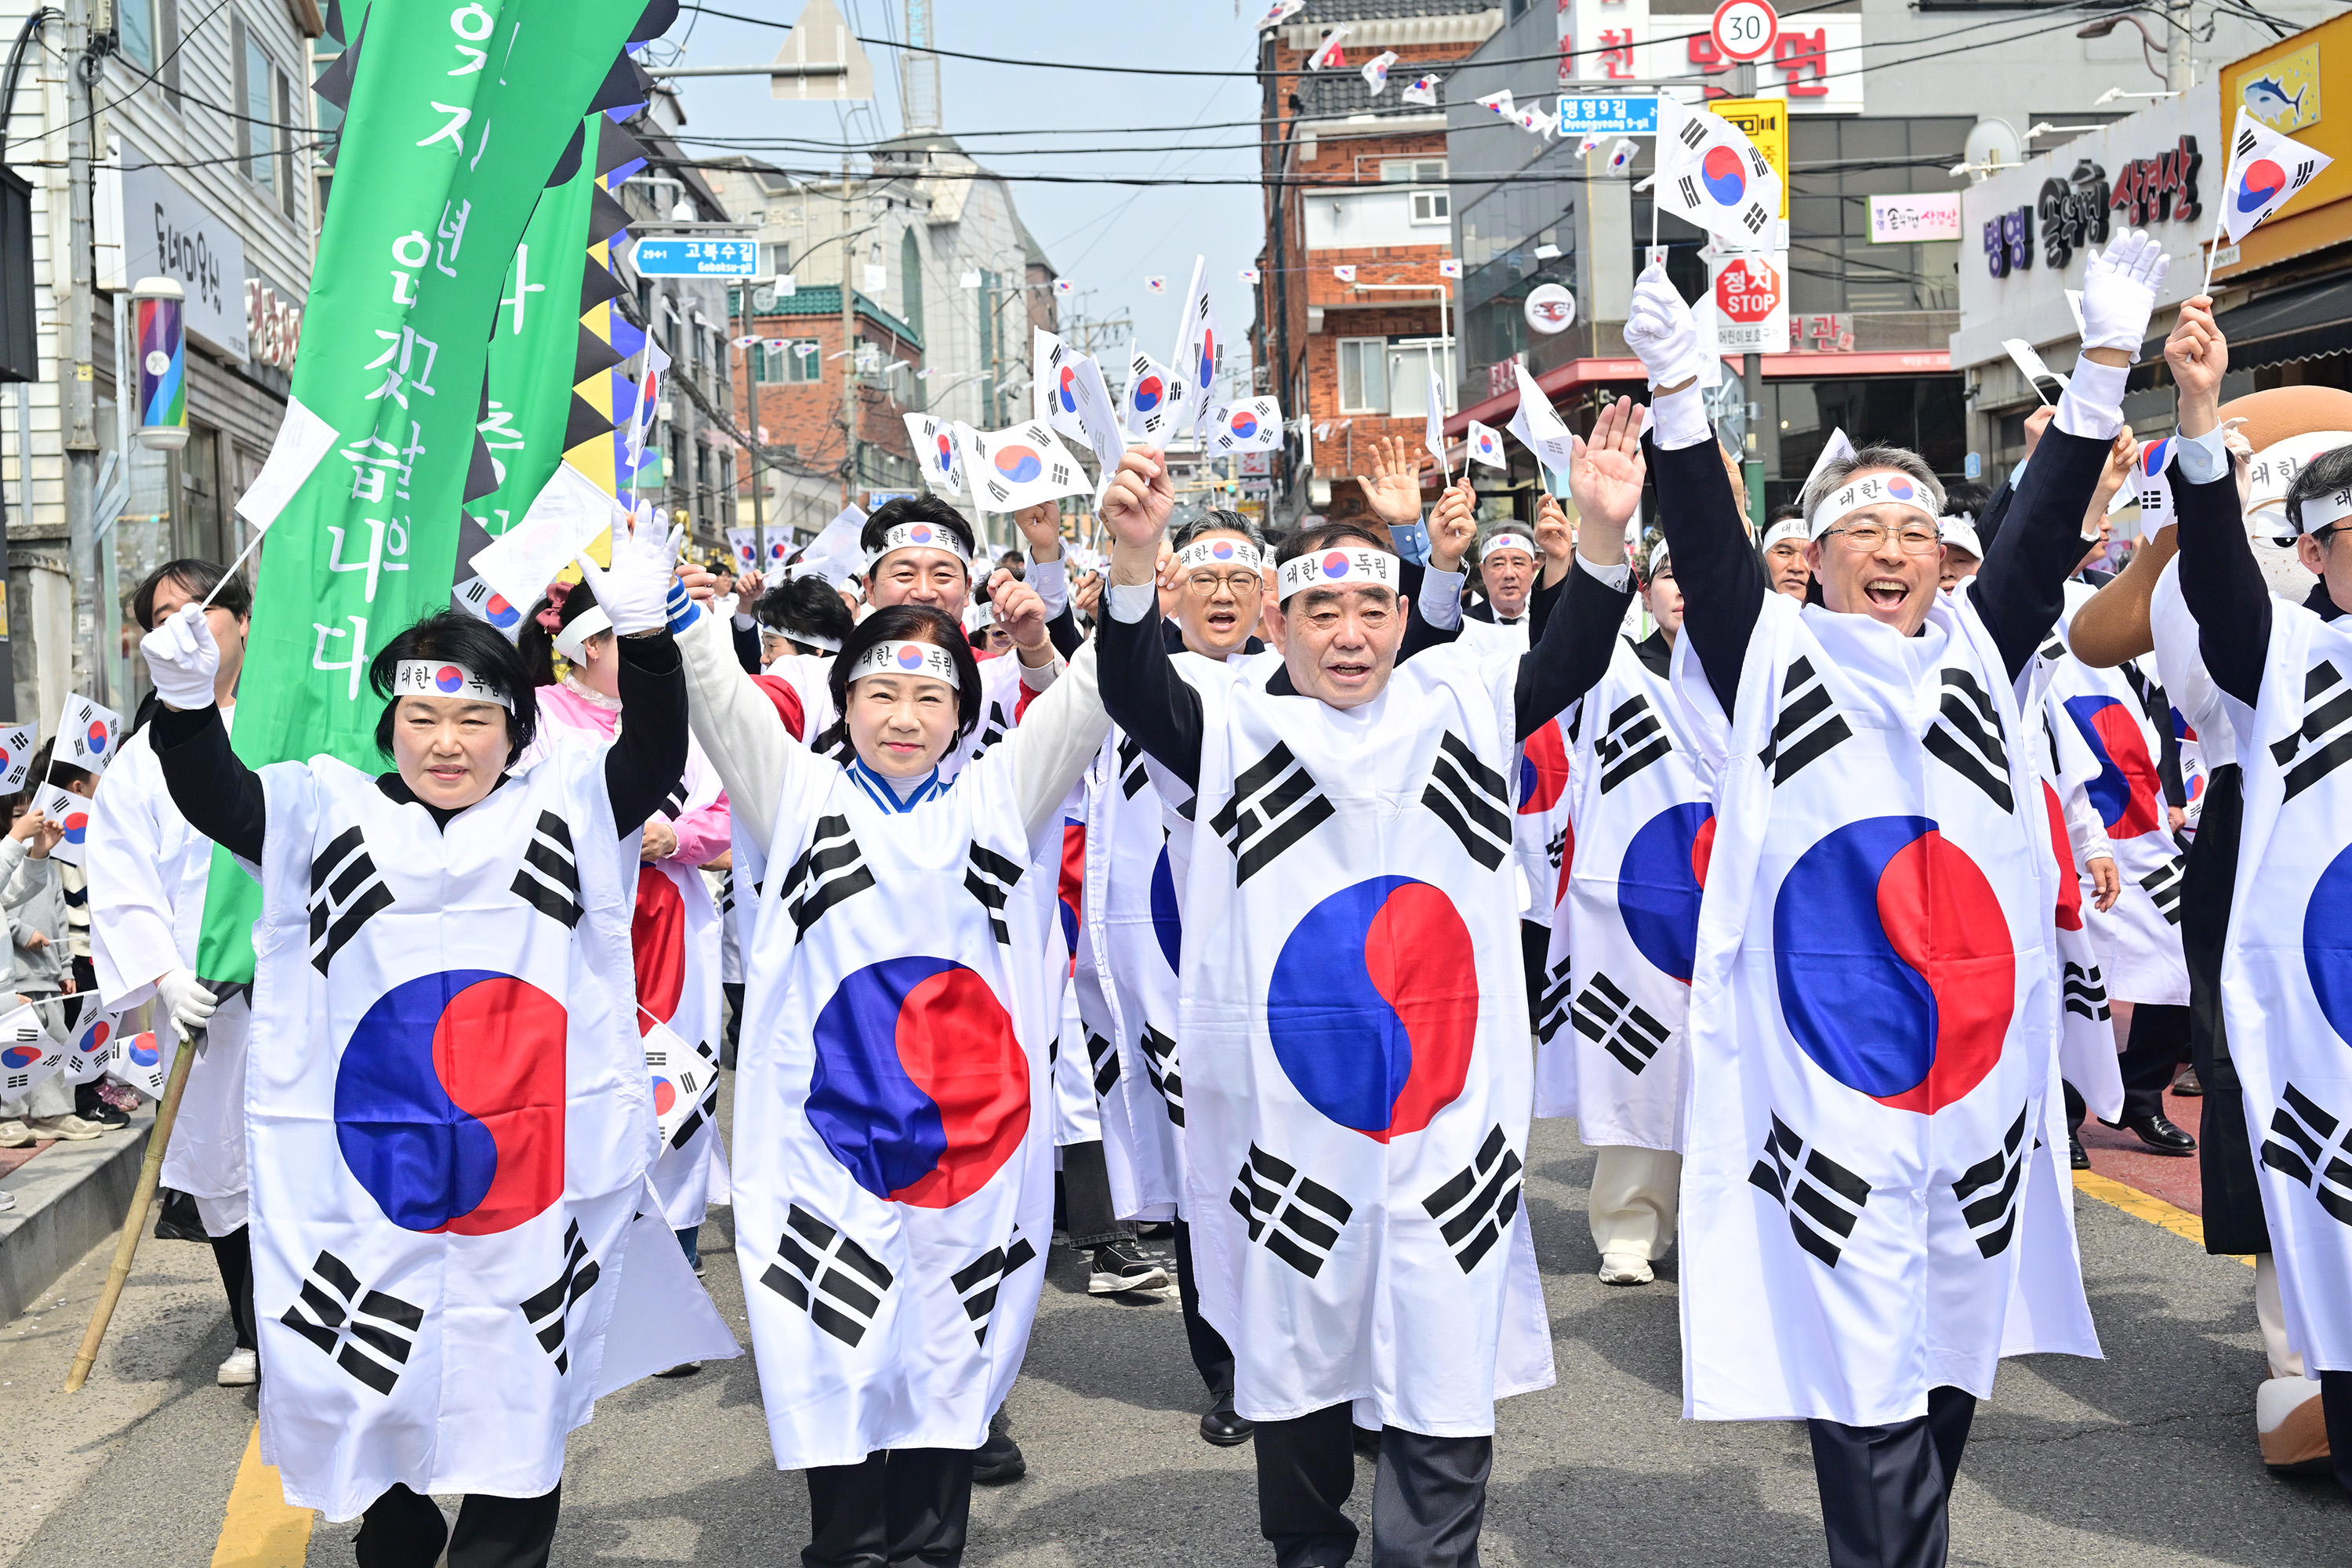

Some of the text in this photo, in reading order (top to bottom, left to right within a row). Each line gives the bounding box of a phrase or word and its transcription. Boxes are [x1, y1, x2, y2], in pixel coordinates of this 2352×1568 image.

[1730, 16, 1761, 41] 30
[154, 202, 221, 314] 동네미용실
[685, 243, 753, 262] 고복수길
[698, 262, 753, 273] Goboksu-gil
[1724, 268, 1772, 293] 정지
[1728, 294, 1776, 313] STOP
[2251, 457, 2299, 488] 대한
[1839, 479, 1882, 506] 대한
[935, 528, 959, 552] 독립
[1181, 544, 1258, 568] 대한 독립
[1287, 554, 1387, 585] 대한 독립
[862, 645, 952, 677] 대한 독립
[401, 666, 431, 690] 대한
